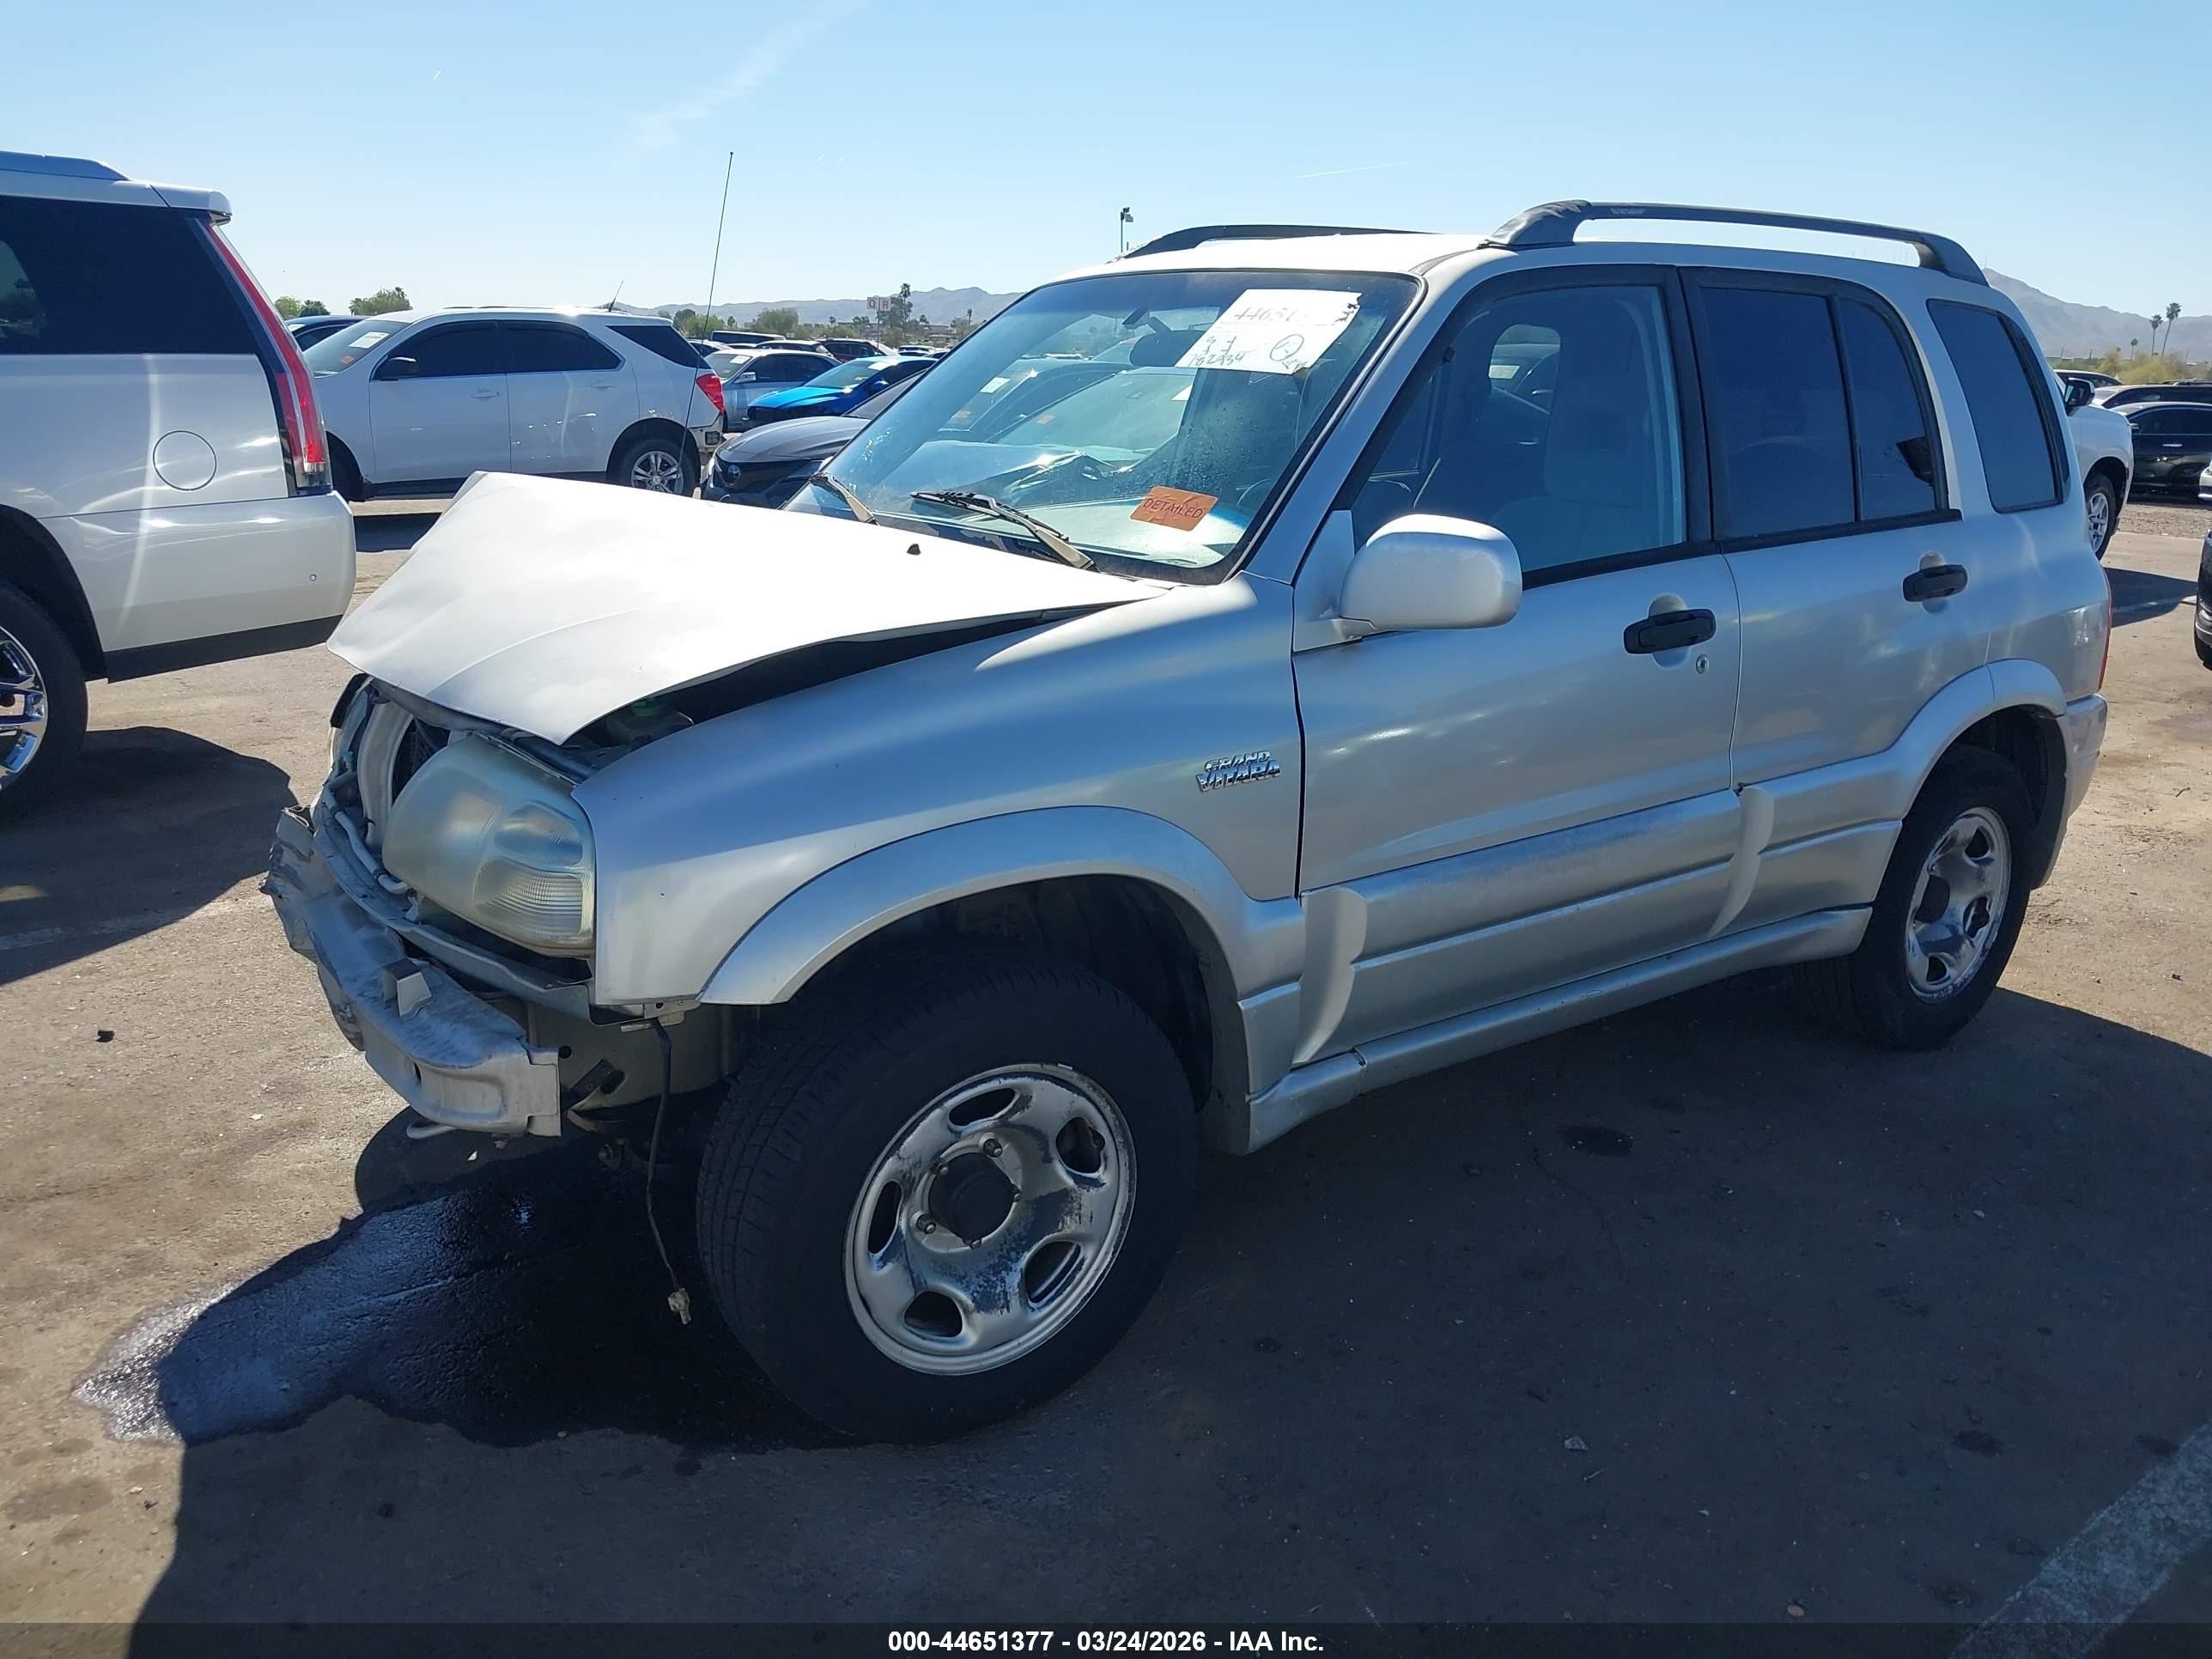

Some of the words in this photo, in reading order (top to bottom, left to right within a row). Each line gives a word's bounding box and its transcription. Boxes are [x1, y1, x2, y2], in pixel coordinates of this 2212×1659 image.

[1143, 498, 1203, 518] DETAILED
[1204, 750, 1271, 773] GRAND
[1195, 760, 1281, 792] VITARA
